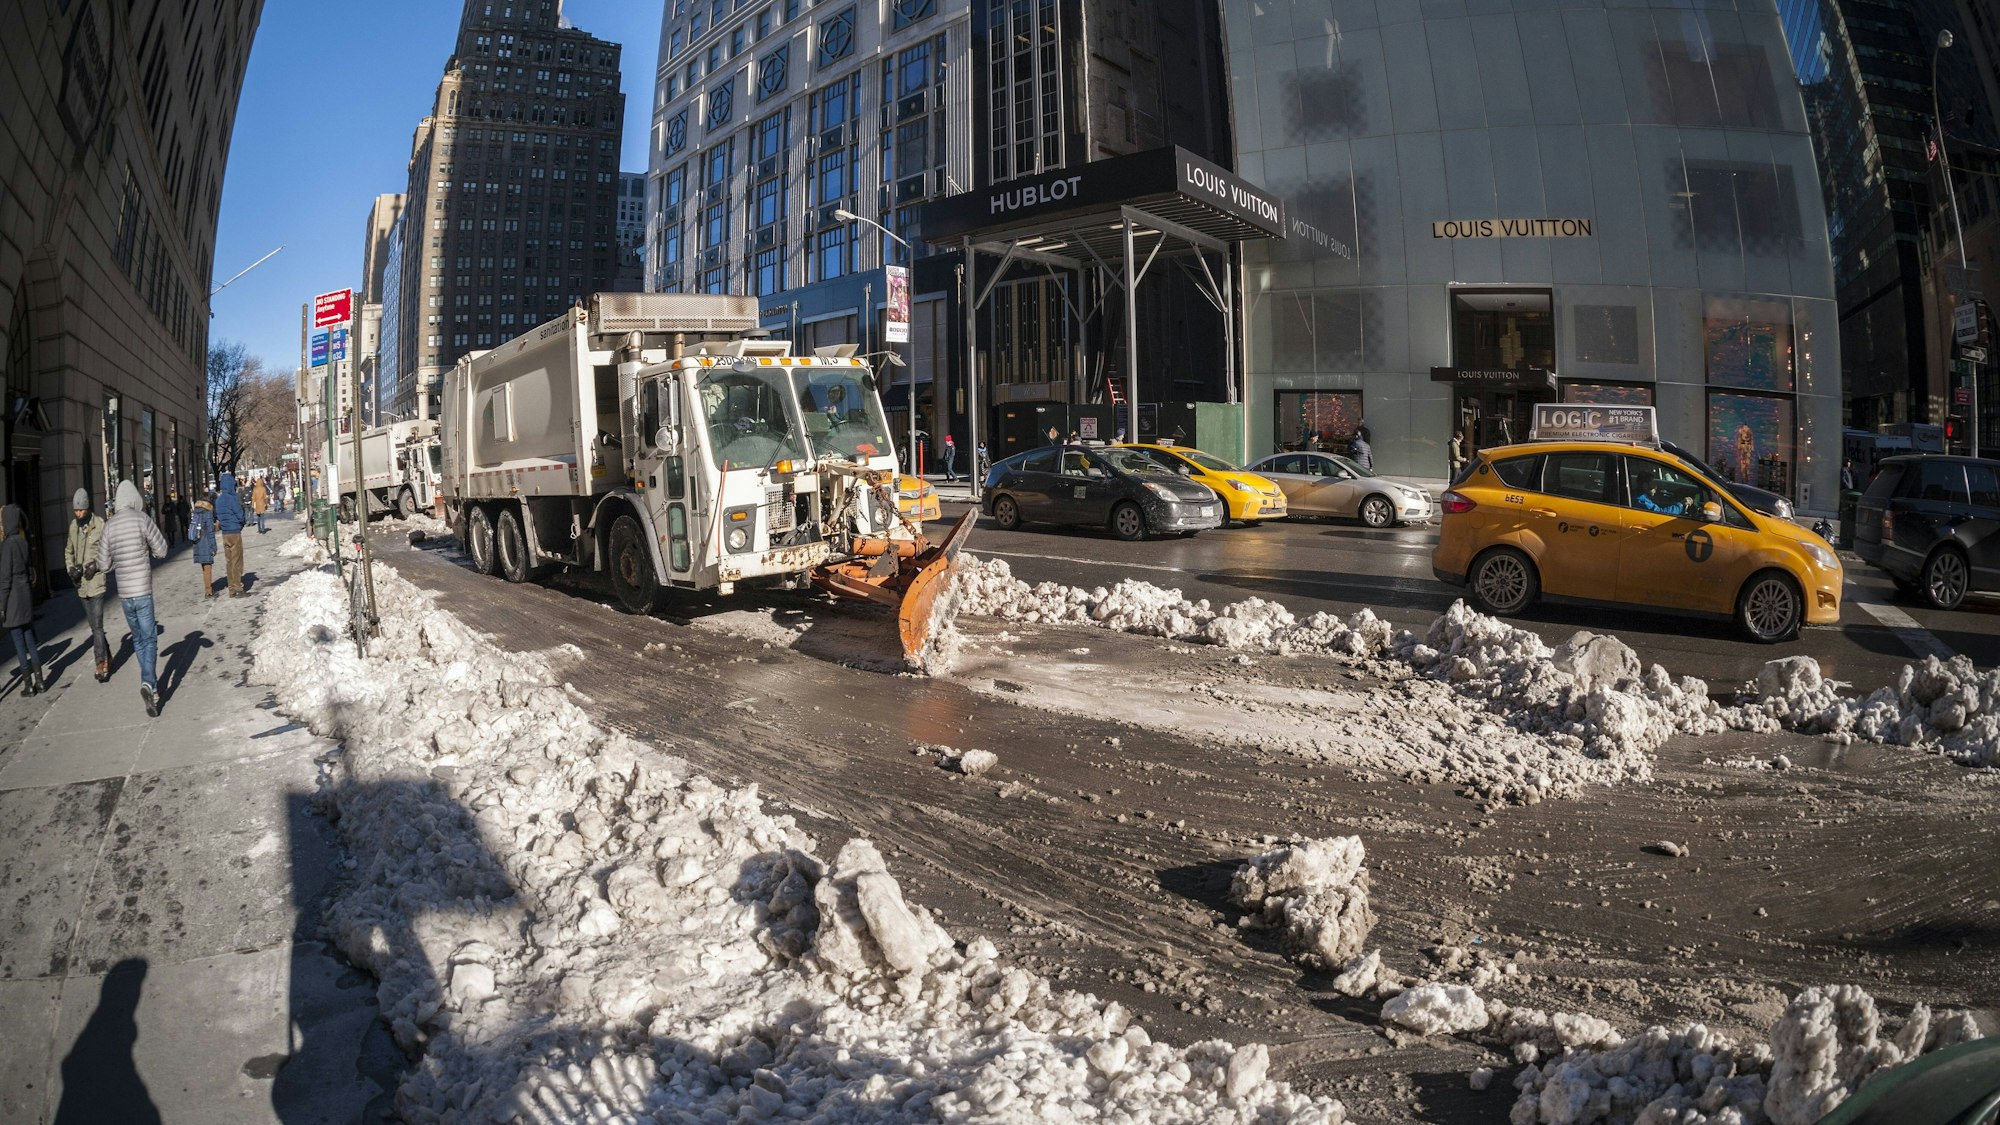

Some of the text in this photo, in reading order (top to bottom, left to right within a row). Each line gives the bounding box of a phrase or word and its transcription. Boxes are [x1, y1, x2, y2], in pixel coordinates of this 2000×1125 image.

[990, 175, 1082, 214] HUBLOT
[1187, 163, 1278, 223] LOUIS VUITTON
[1432, 219, 1592, 239] LOUIS VUITTON
[316, 293, 346, 306] NO STANDING
[317, 304, 336, 314] Anytime
[540, 319, 569, 341] sanitation
[1457, 370, 1520, 380] LOUIS VUITTON
[1541, 409, 1602, 429] LOGIC
[1608, 415, 1644, 425] #1 BRAND
[1622, 409, 1643, 417] YORK'S
